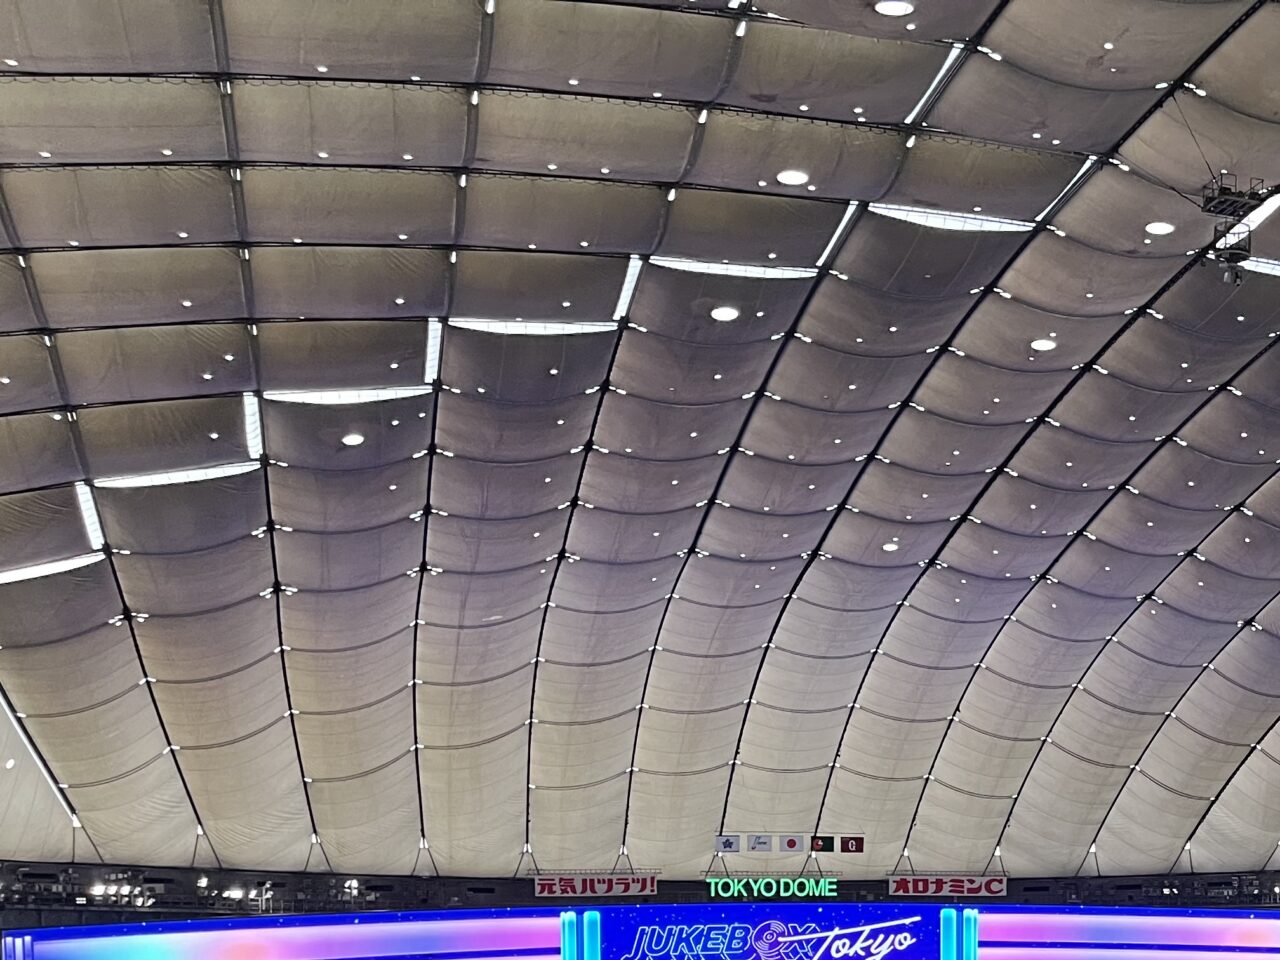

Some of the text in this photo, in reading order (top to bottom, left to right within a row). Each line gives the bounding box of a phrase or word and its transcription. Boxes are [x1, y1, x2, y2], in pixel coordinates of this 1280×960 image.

[705, 878, 838, 897] TOKYO DOME
[892, 877, 1004, 896] オロナミンC
